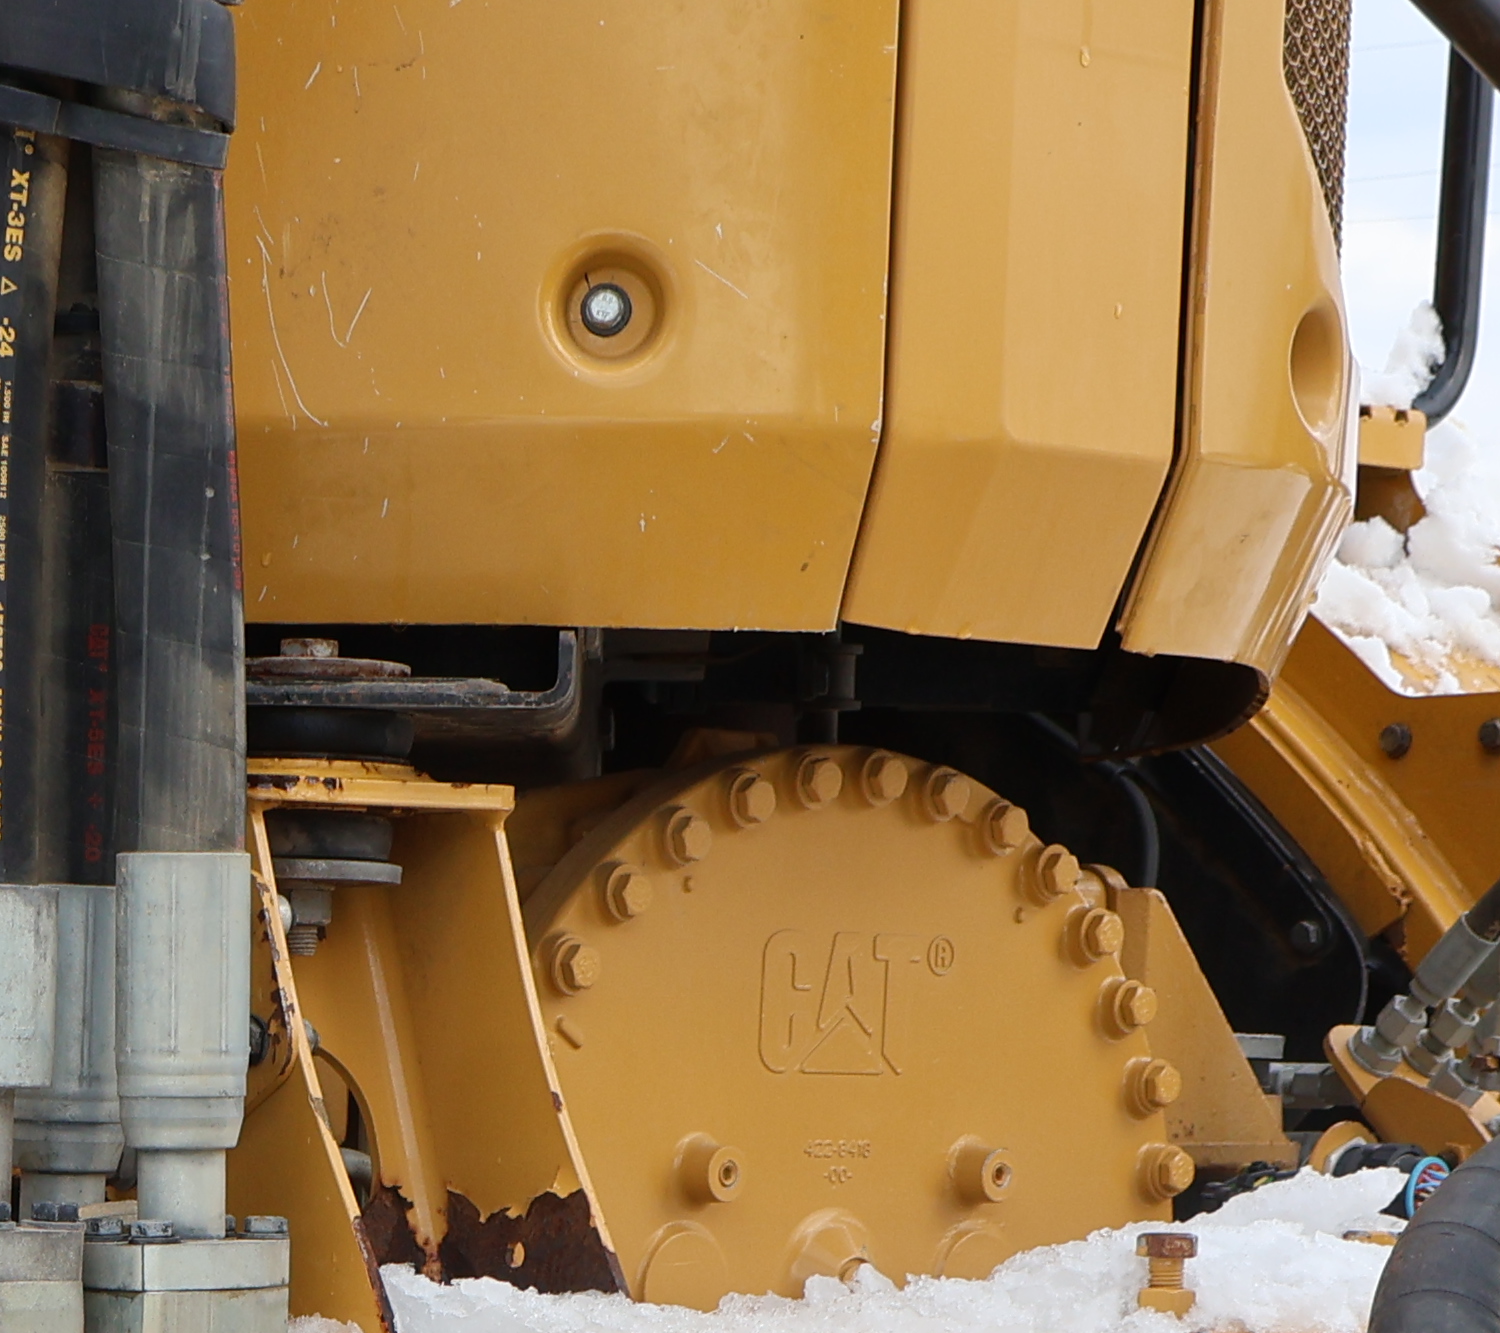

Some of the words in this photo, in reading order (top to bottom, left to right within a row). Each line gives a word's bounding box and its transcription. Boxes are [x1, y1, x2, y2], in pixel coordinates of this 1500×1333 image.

[4, 168, 31, 263] XT-3ES
[1, 436, 10, 457] SAE
[0, 543, 7, 561] PSI
[0, 563, 6, 581] WP
